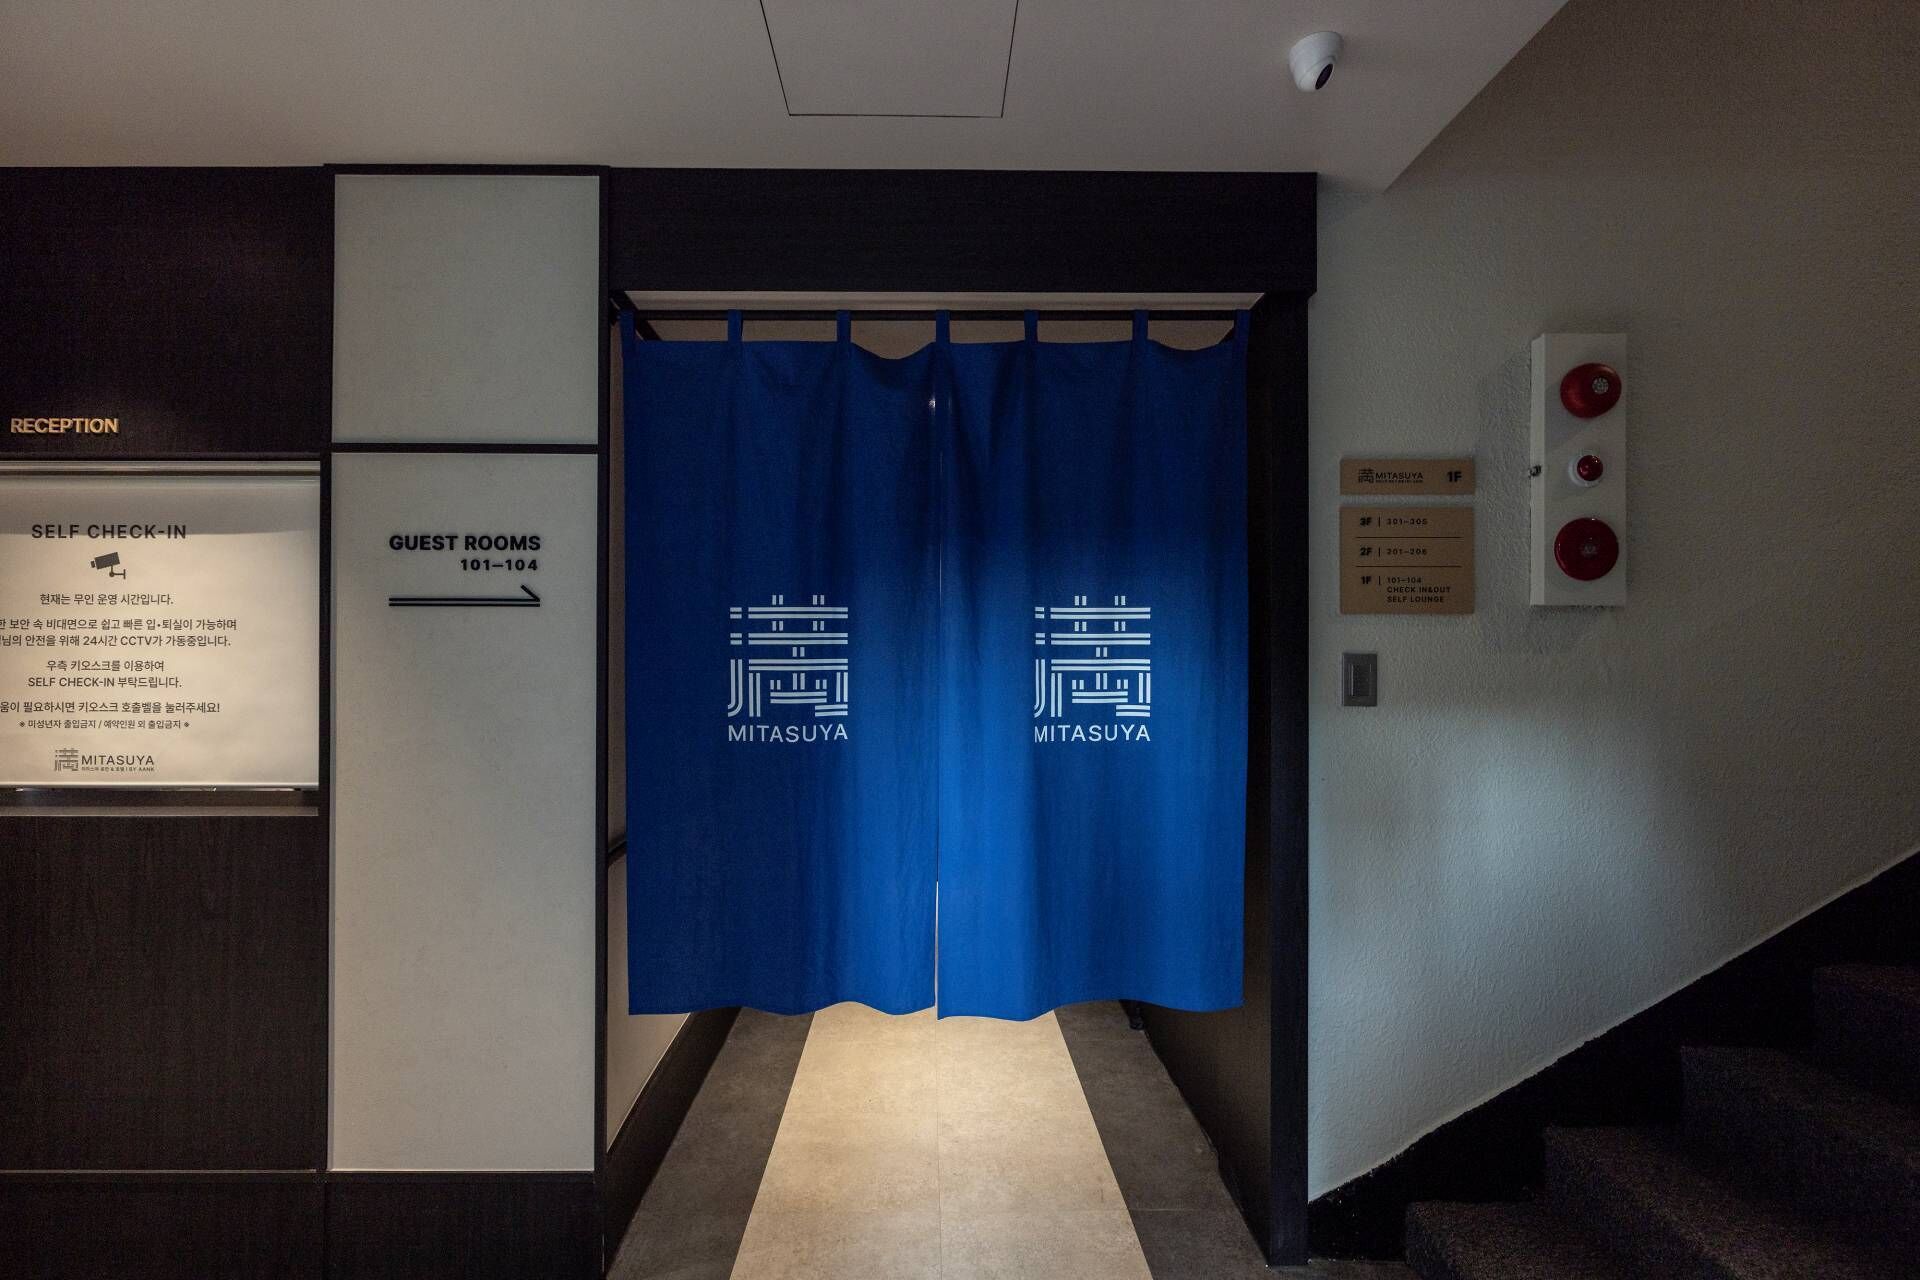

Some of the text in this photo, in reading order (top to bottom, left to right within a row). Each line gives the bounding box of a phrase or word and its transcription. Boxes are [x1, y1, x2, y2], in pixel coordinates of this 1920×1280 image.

[10, 417, 119, 434] RECEPTION
[1375, 471, 1424, 480] MITASUYA
[1446, 471, 1463, 483] 1F
[1359, 517, 1373, 527] 3F
[31, 524, 187, 540] SELF CHECK-IN
[389, 535, 541, 551] GUEST ROOMS
[1359, 546, 1373, 556] 2F
[1360, 575, 1372, 585] 1F
[1386, 586, 1416, 594] CHECK
[40, 593, 174, 606] 현재는 무인 운영 시간입니다.
[1386, 595, 1444, 603] SELF LOUNGE
[10, 618, 31, 630] 보안
[33, 618, 44, 630] 속
[46, 618, 98, 630] 비대면으로
[101, 618, 121, 631] 쉽고
[123, 618, 144, 631] 빠른
[196, 618, 237, 631] 가능하며
[0, 634, 231, 648] 님의 안전을 위해 24시간 CCTV가 가동중입니다.
[46, 660, 165, 672] 우측 키오스크를 이용하여
[28, 676, 182, 688] SELF CHECK-IN 부탁드립니다.
[24, 701, 75, 713] 필요하시면
[78, 701, 119, 713] 키오스크
[121, 701, 162, 714] 호출벨을
[165, 701, 220, 714] 눌러주세요!
[27, 719, 62, 729] 미성년자
[64, 719, 96, 729] 출입금지
[728, 723, 849, 743] MITASUYA
[1034, 724, 1151, 743] MITASUYA
[82, 755, 155, 766] MITASUYA
